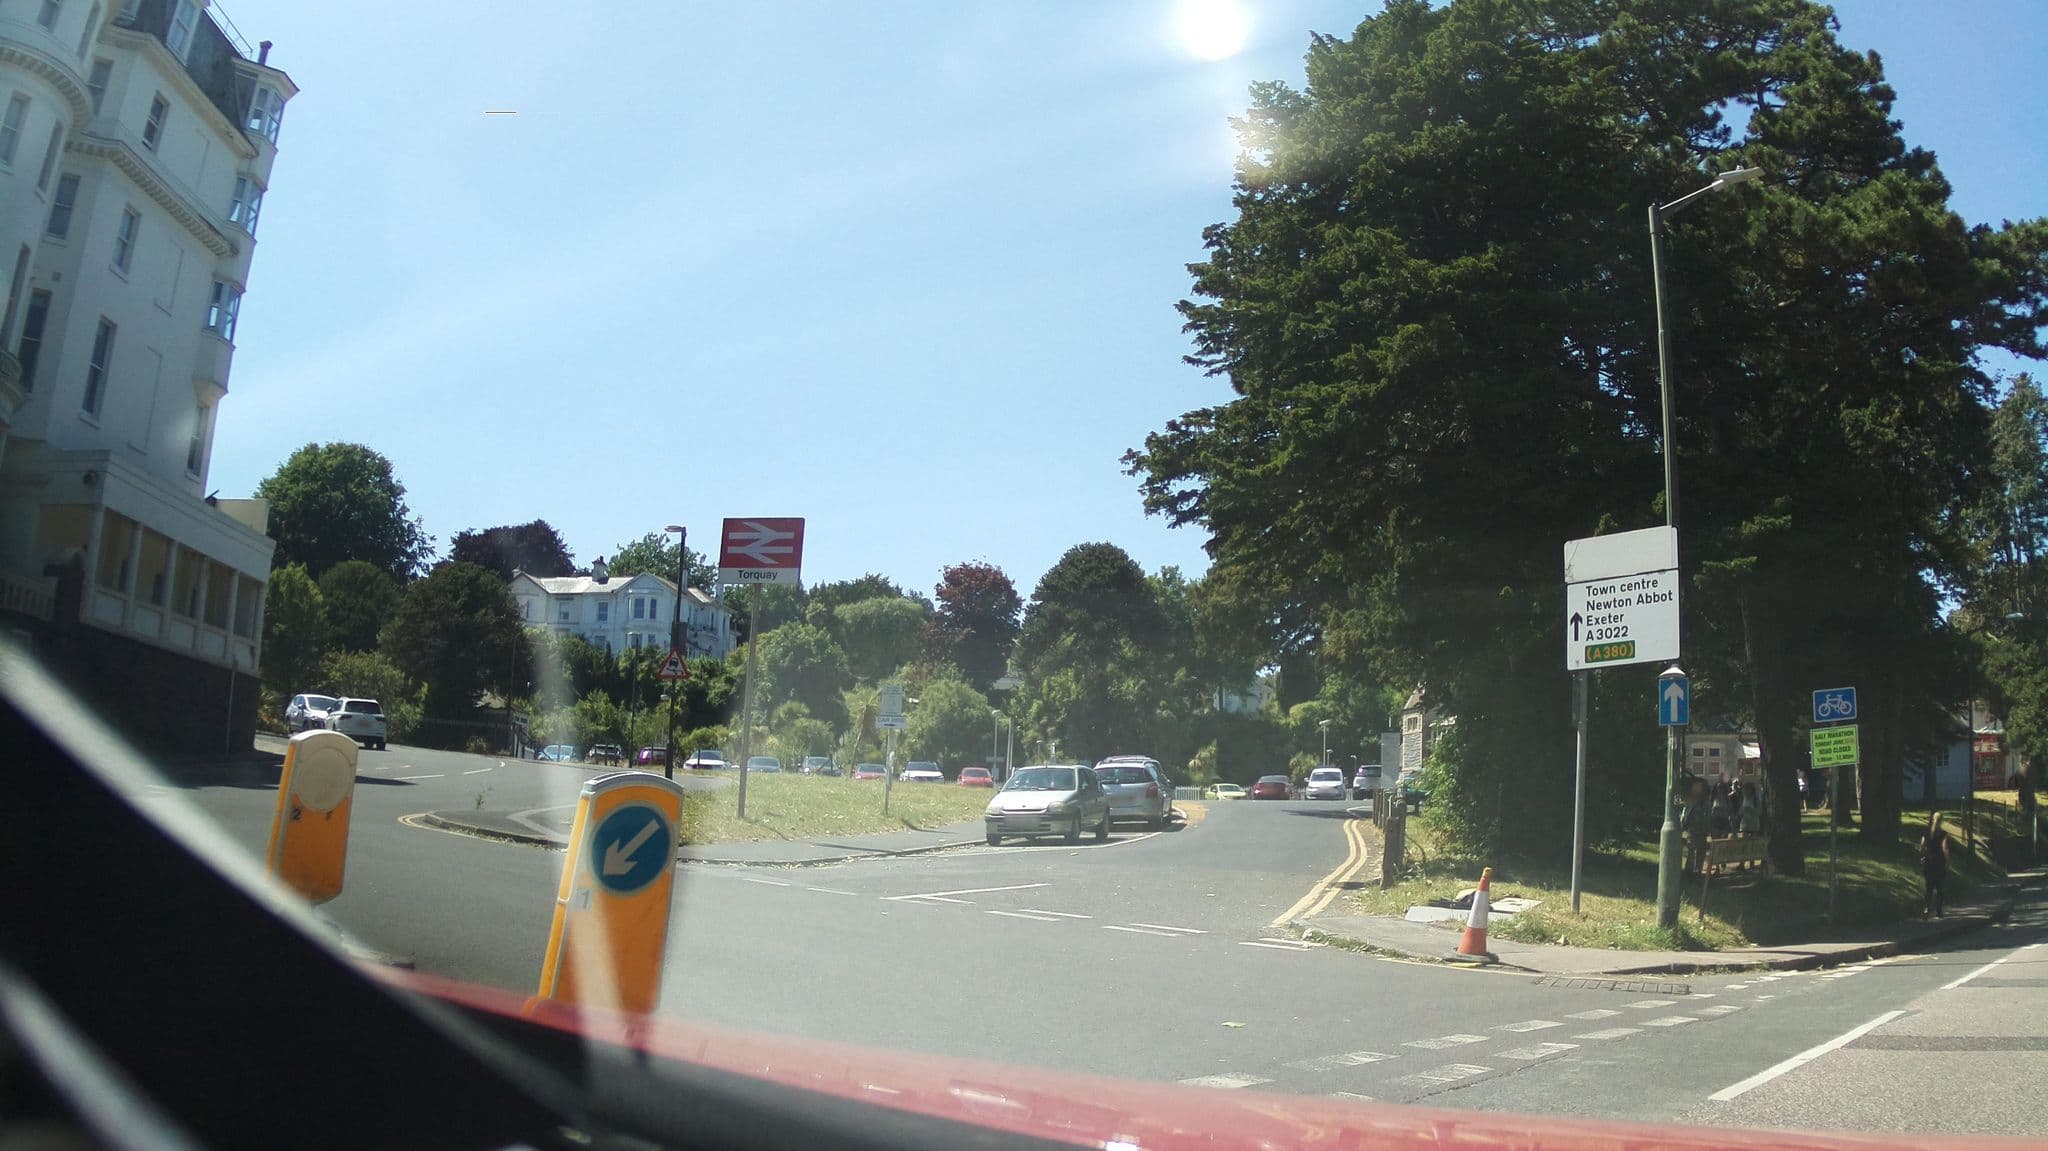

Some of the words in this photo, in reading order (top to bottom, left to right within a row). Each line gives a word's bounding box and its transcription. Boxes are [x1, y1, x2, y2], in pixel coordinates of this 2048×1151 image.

[738, 570, 777, 581] Torquay
[1586, 585, 1616, 597] Town
[1620, 578, 1658, 592] centre
[1586, 597, 1632, 611] Newton
[1636, 590, 1673, 605] Abbot
[1586, 613, 1624, 626] Exeter
[1586, 625, 1629, 641] A3022
[1586, 642, 1634, 660] (A380)
[1828, 730, 1854, 738] MARATHON
[1833, 745, 1851, 753] CLOSED
